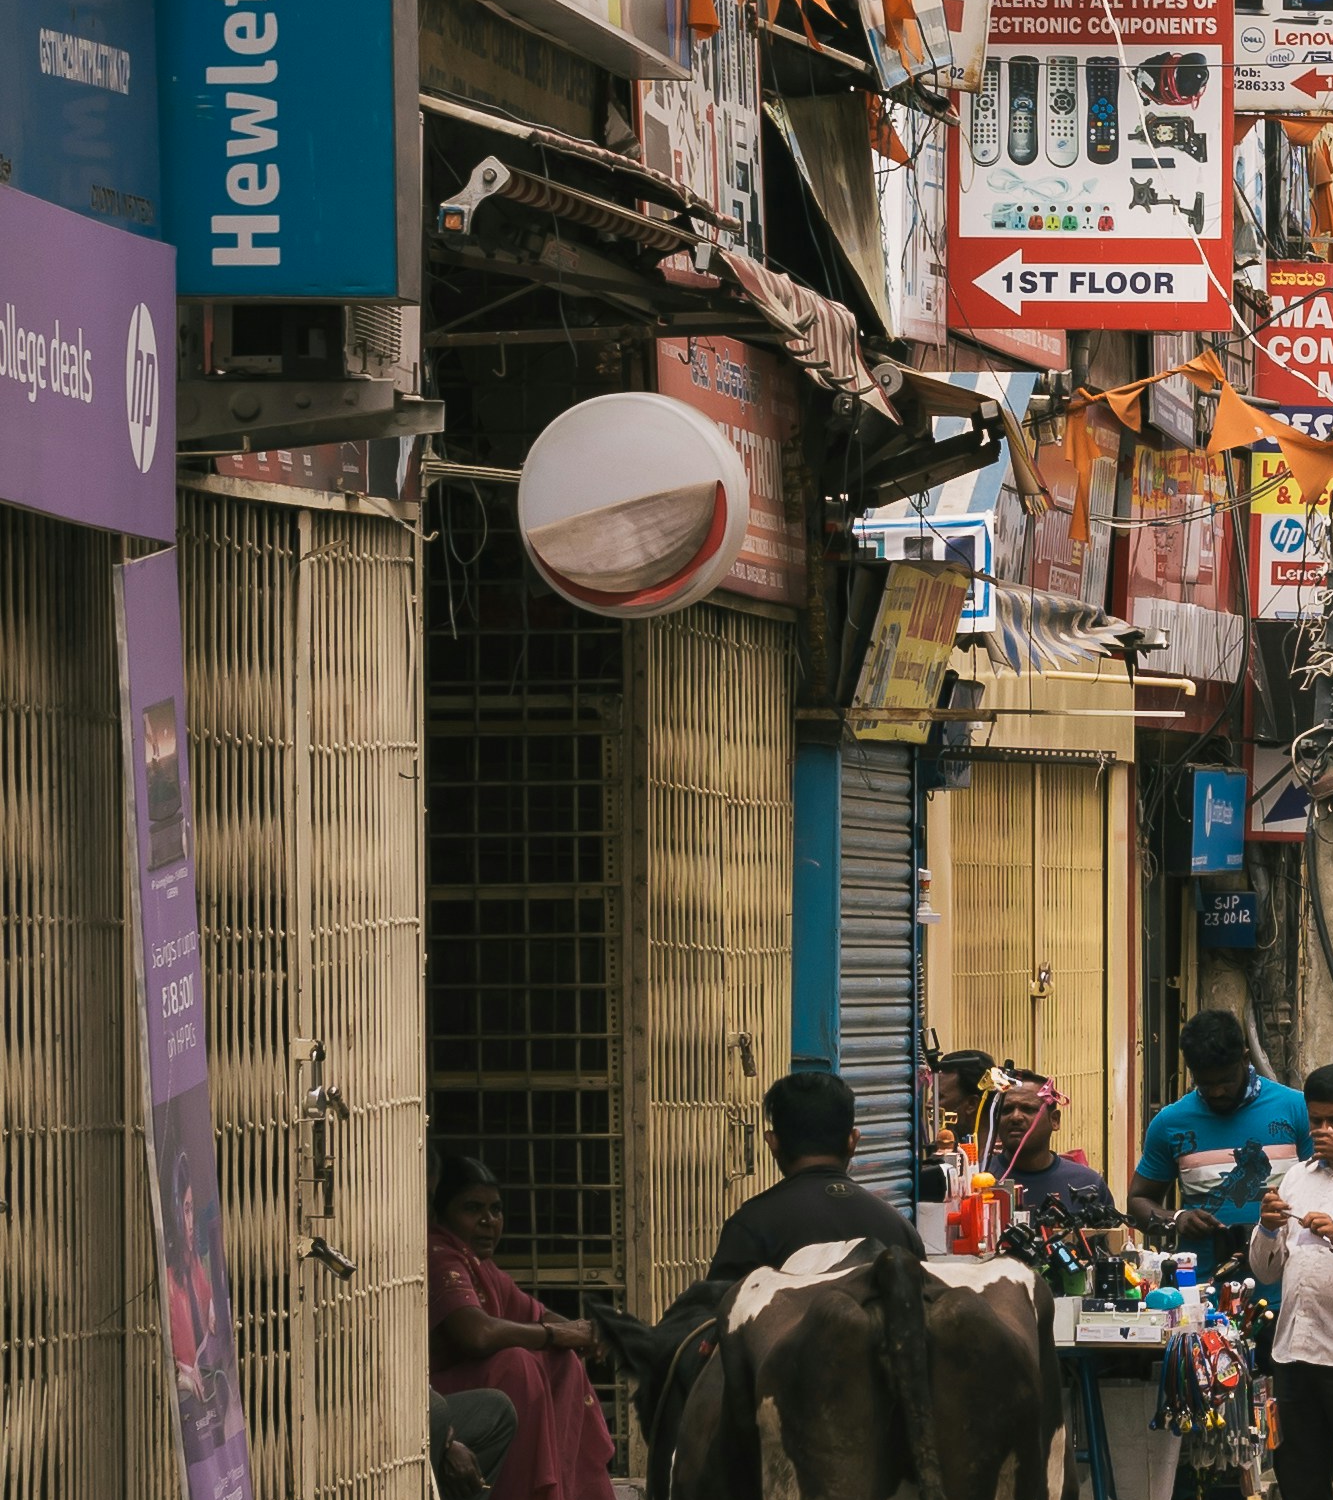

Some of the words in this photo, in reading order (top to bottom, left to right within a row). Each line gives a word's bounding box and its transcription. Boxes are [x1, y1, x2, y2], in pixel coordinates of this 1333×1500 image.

[1094, 17, 1217, 34] COMPONENTS
[1069, 271, 1174, 295] FLOOR
[51, 320, 92, 403] deals
